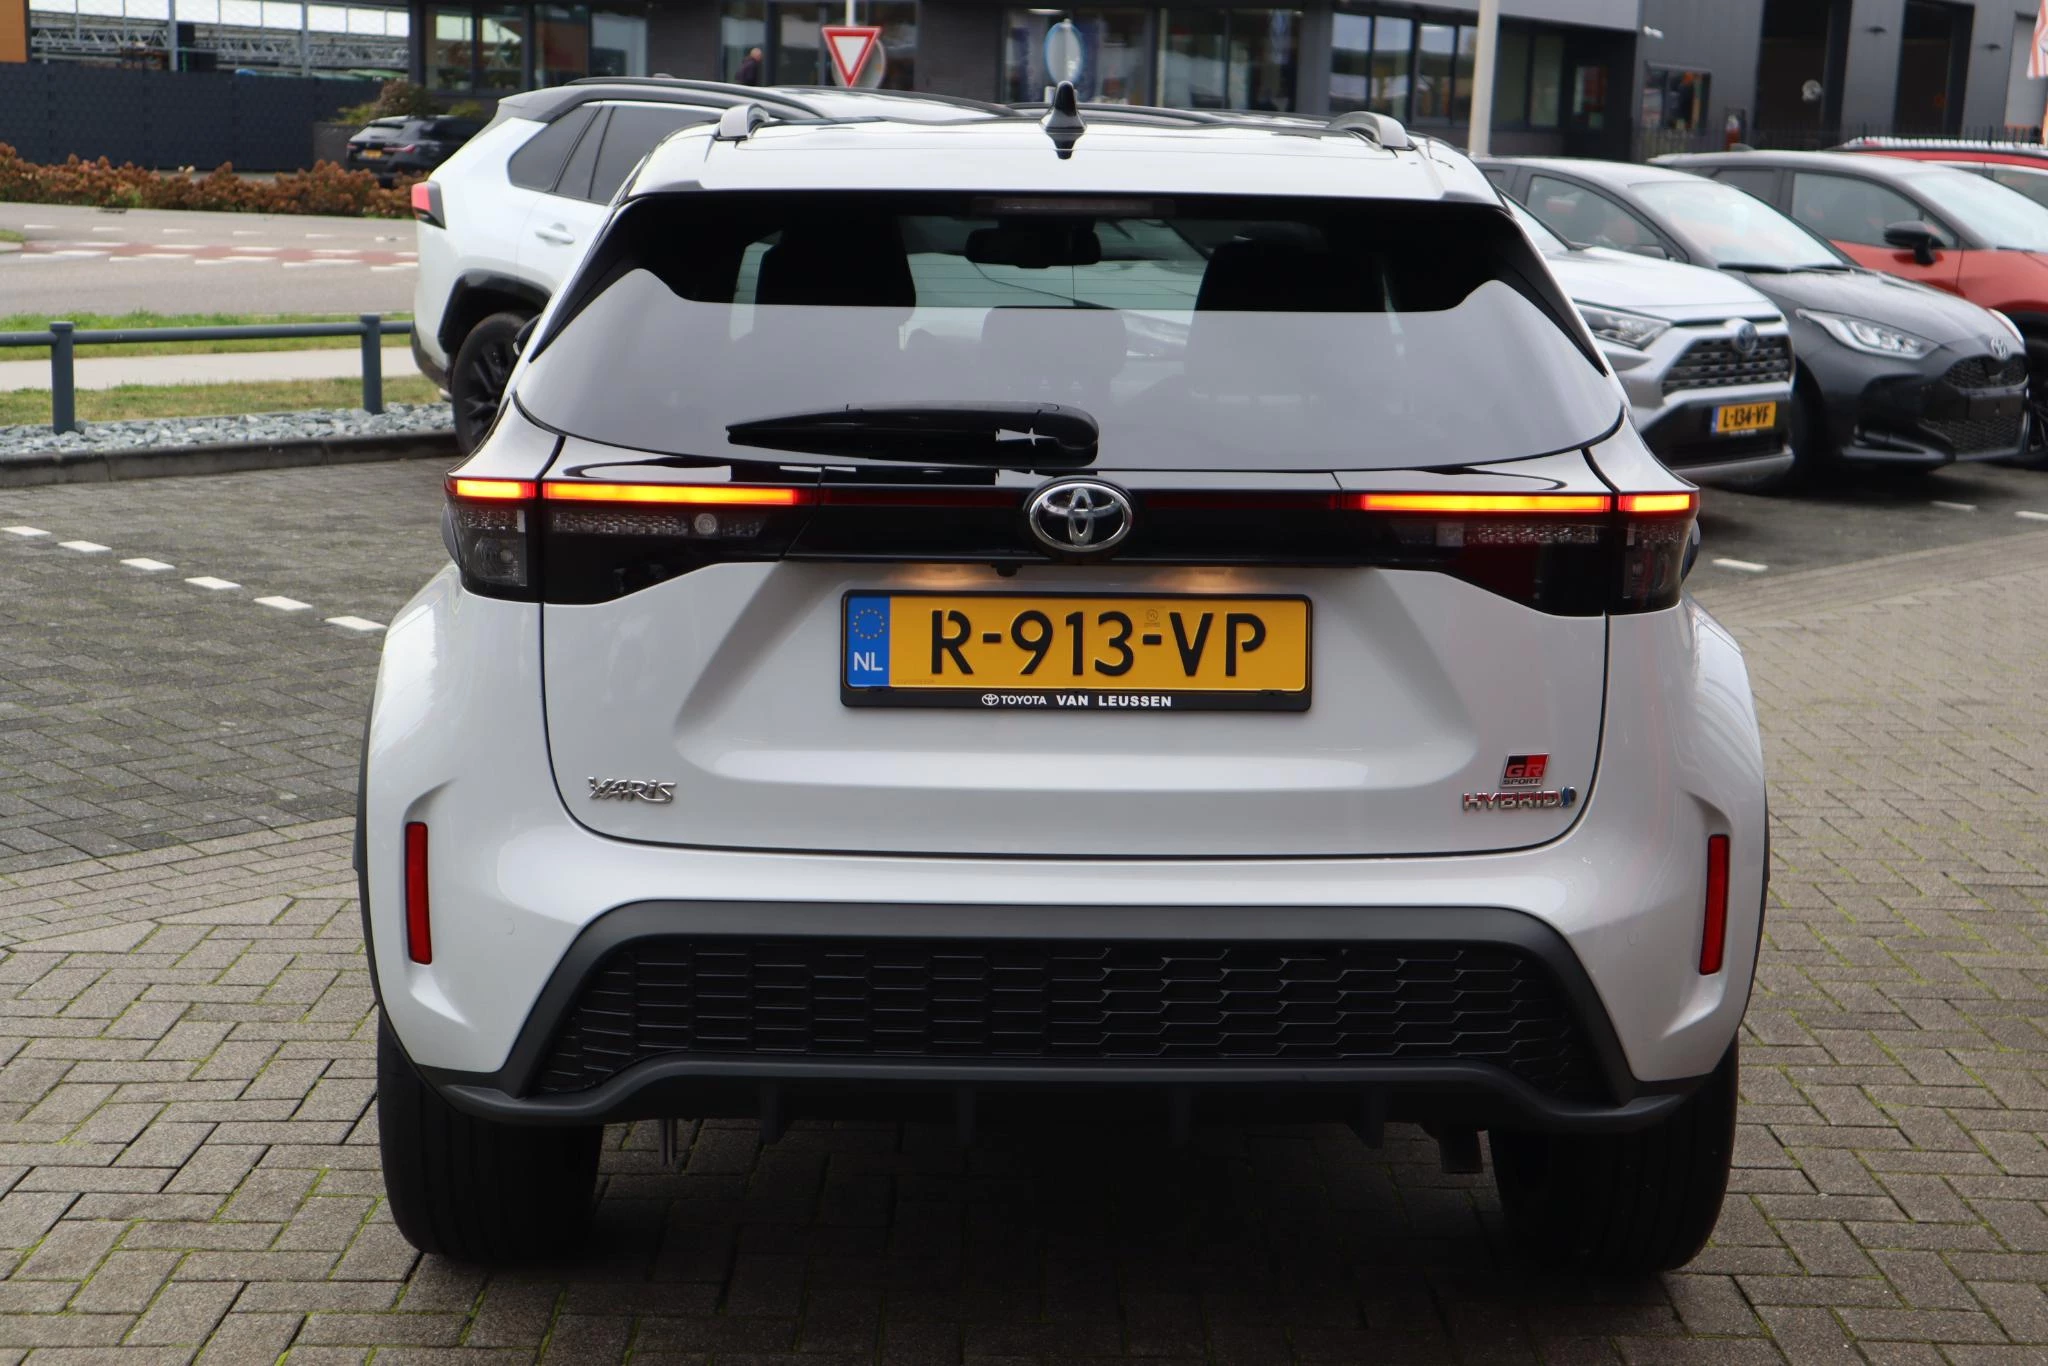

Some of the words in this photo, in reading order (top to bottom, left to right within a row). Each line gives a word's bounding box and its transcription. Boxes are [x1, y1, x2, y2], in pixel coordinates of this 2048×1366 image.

[1722, 404, 1770, 428] L-134-VF
[930, 608, 1267, 677] R-913-VP
[853, 651, 883, 671] NL
[1001, 695, 1047, 705] TOYOTA
[1056, 695, 1089, 706] VAN
[1099, 695, 1172, 707] LEUSSEN
[1506, 764, 1544, 777] GR
[1463, 791, 1560, 811] HYBRID
